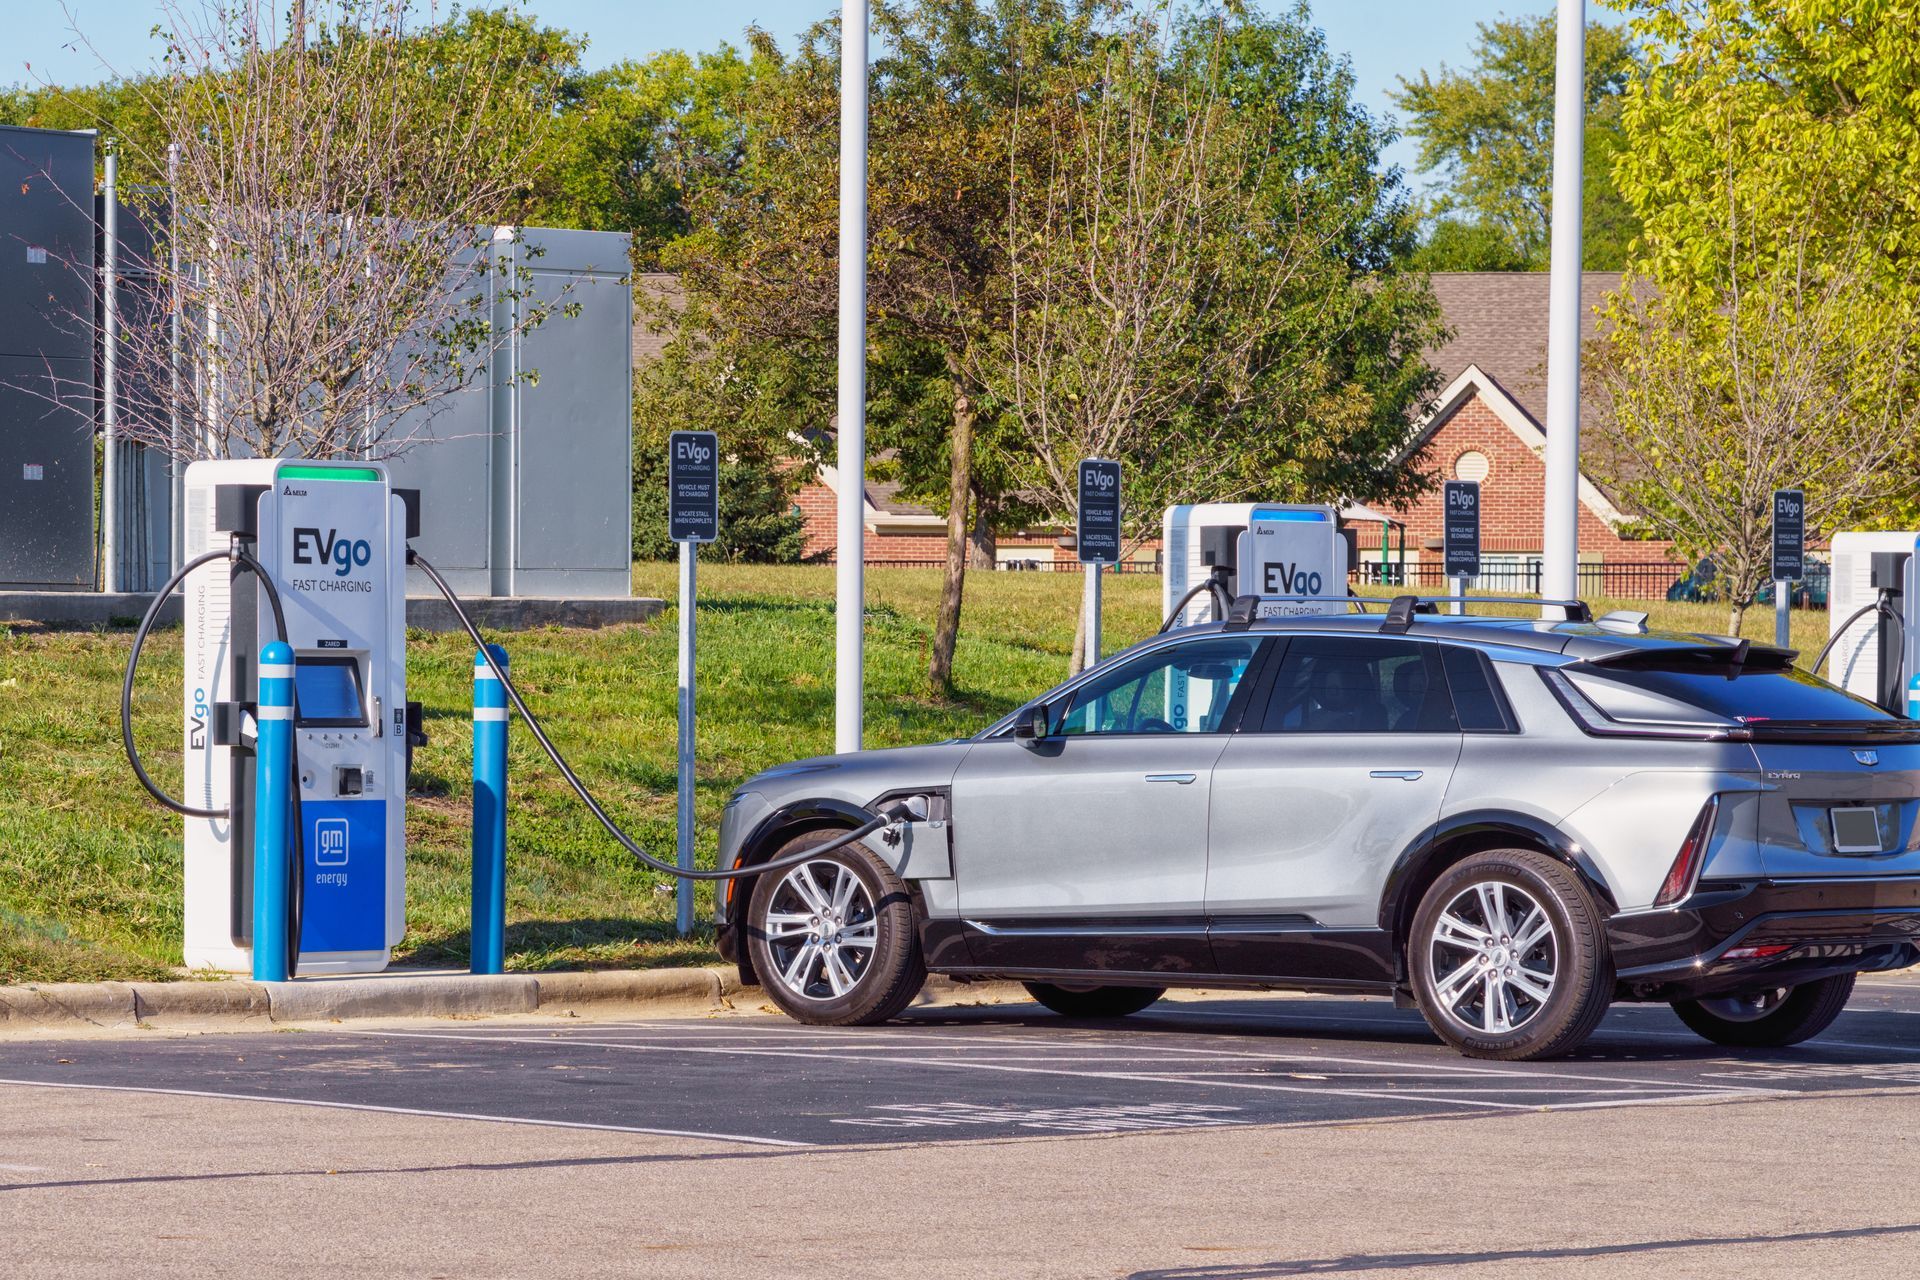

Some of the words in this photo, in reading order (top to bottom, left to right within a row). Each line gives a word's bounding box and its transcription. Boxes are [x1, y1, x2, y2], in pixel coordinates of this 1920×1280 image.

[678, 442, 710, 464] EVgo
[1086, 470, 1114, 490] EVgo
[1450, 490, 1474, 509] EVgo
[1778, 499, 1799, 517] EVgo
[293, 527, 371, 576] EVgo
[293, 580, 317, 591] FAST
[320, 580, 371, 592] CHARGING
[1264, 562, 1322, 603] EVgo
[1264, 607, 1282, 616] FAST
[190, 688, 209, 750] EVgo
[396, 725, 401, 734] B
[321, 830, 343, 854] gm
[1470, 864, 1518, 875] MICHELIN
[316, 873, 348, 886] energy
